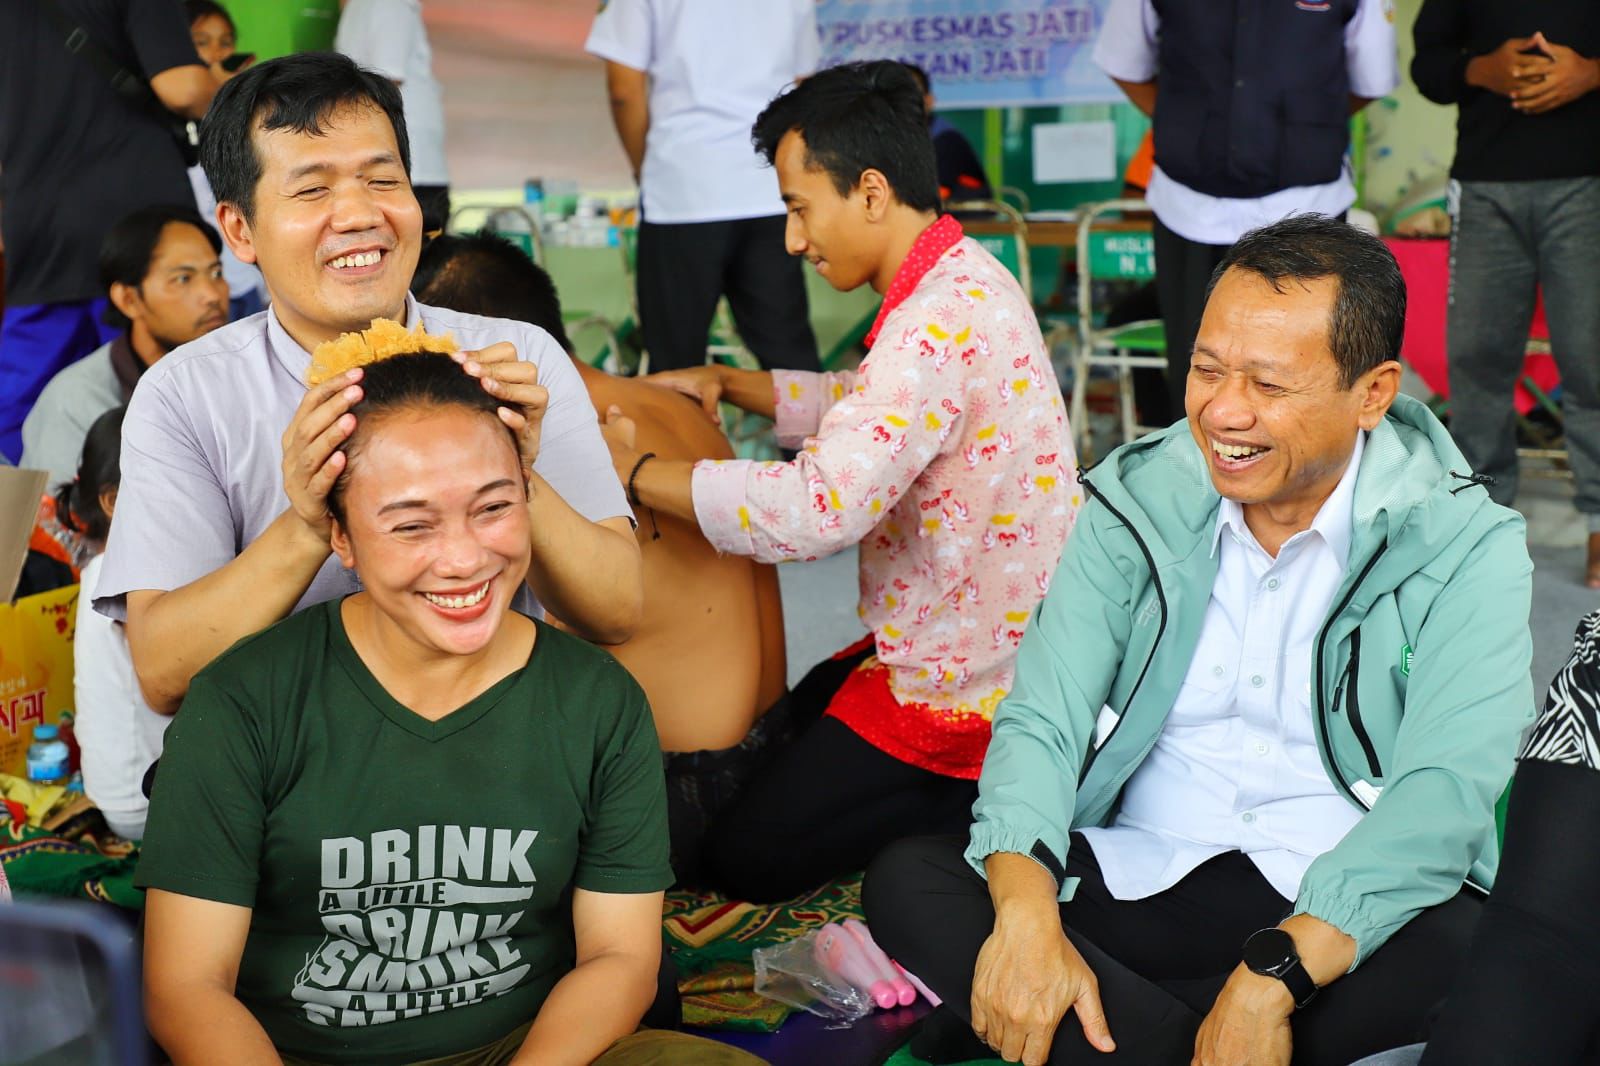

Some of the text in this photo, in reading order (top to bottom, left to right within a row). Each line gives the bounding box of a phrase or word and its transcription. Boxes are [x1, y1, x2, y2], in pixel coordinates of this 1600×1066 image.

[828, 17, 1016, 44] PUSKESMAS
[1024, 9, 1093, 36] JATI
[982, 48, 1045, 75] JATI
[320, 825, 539, 888] DRINK
[320, 881, 446, 911] A LITTLE
[321, 908, 525, 961] DRINK
[348, 994, 367, 1010] A
